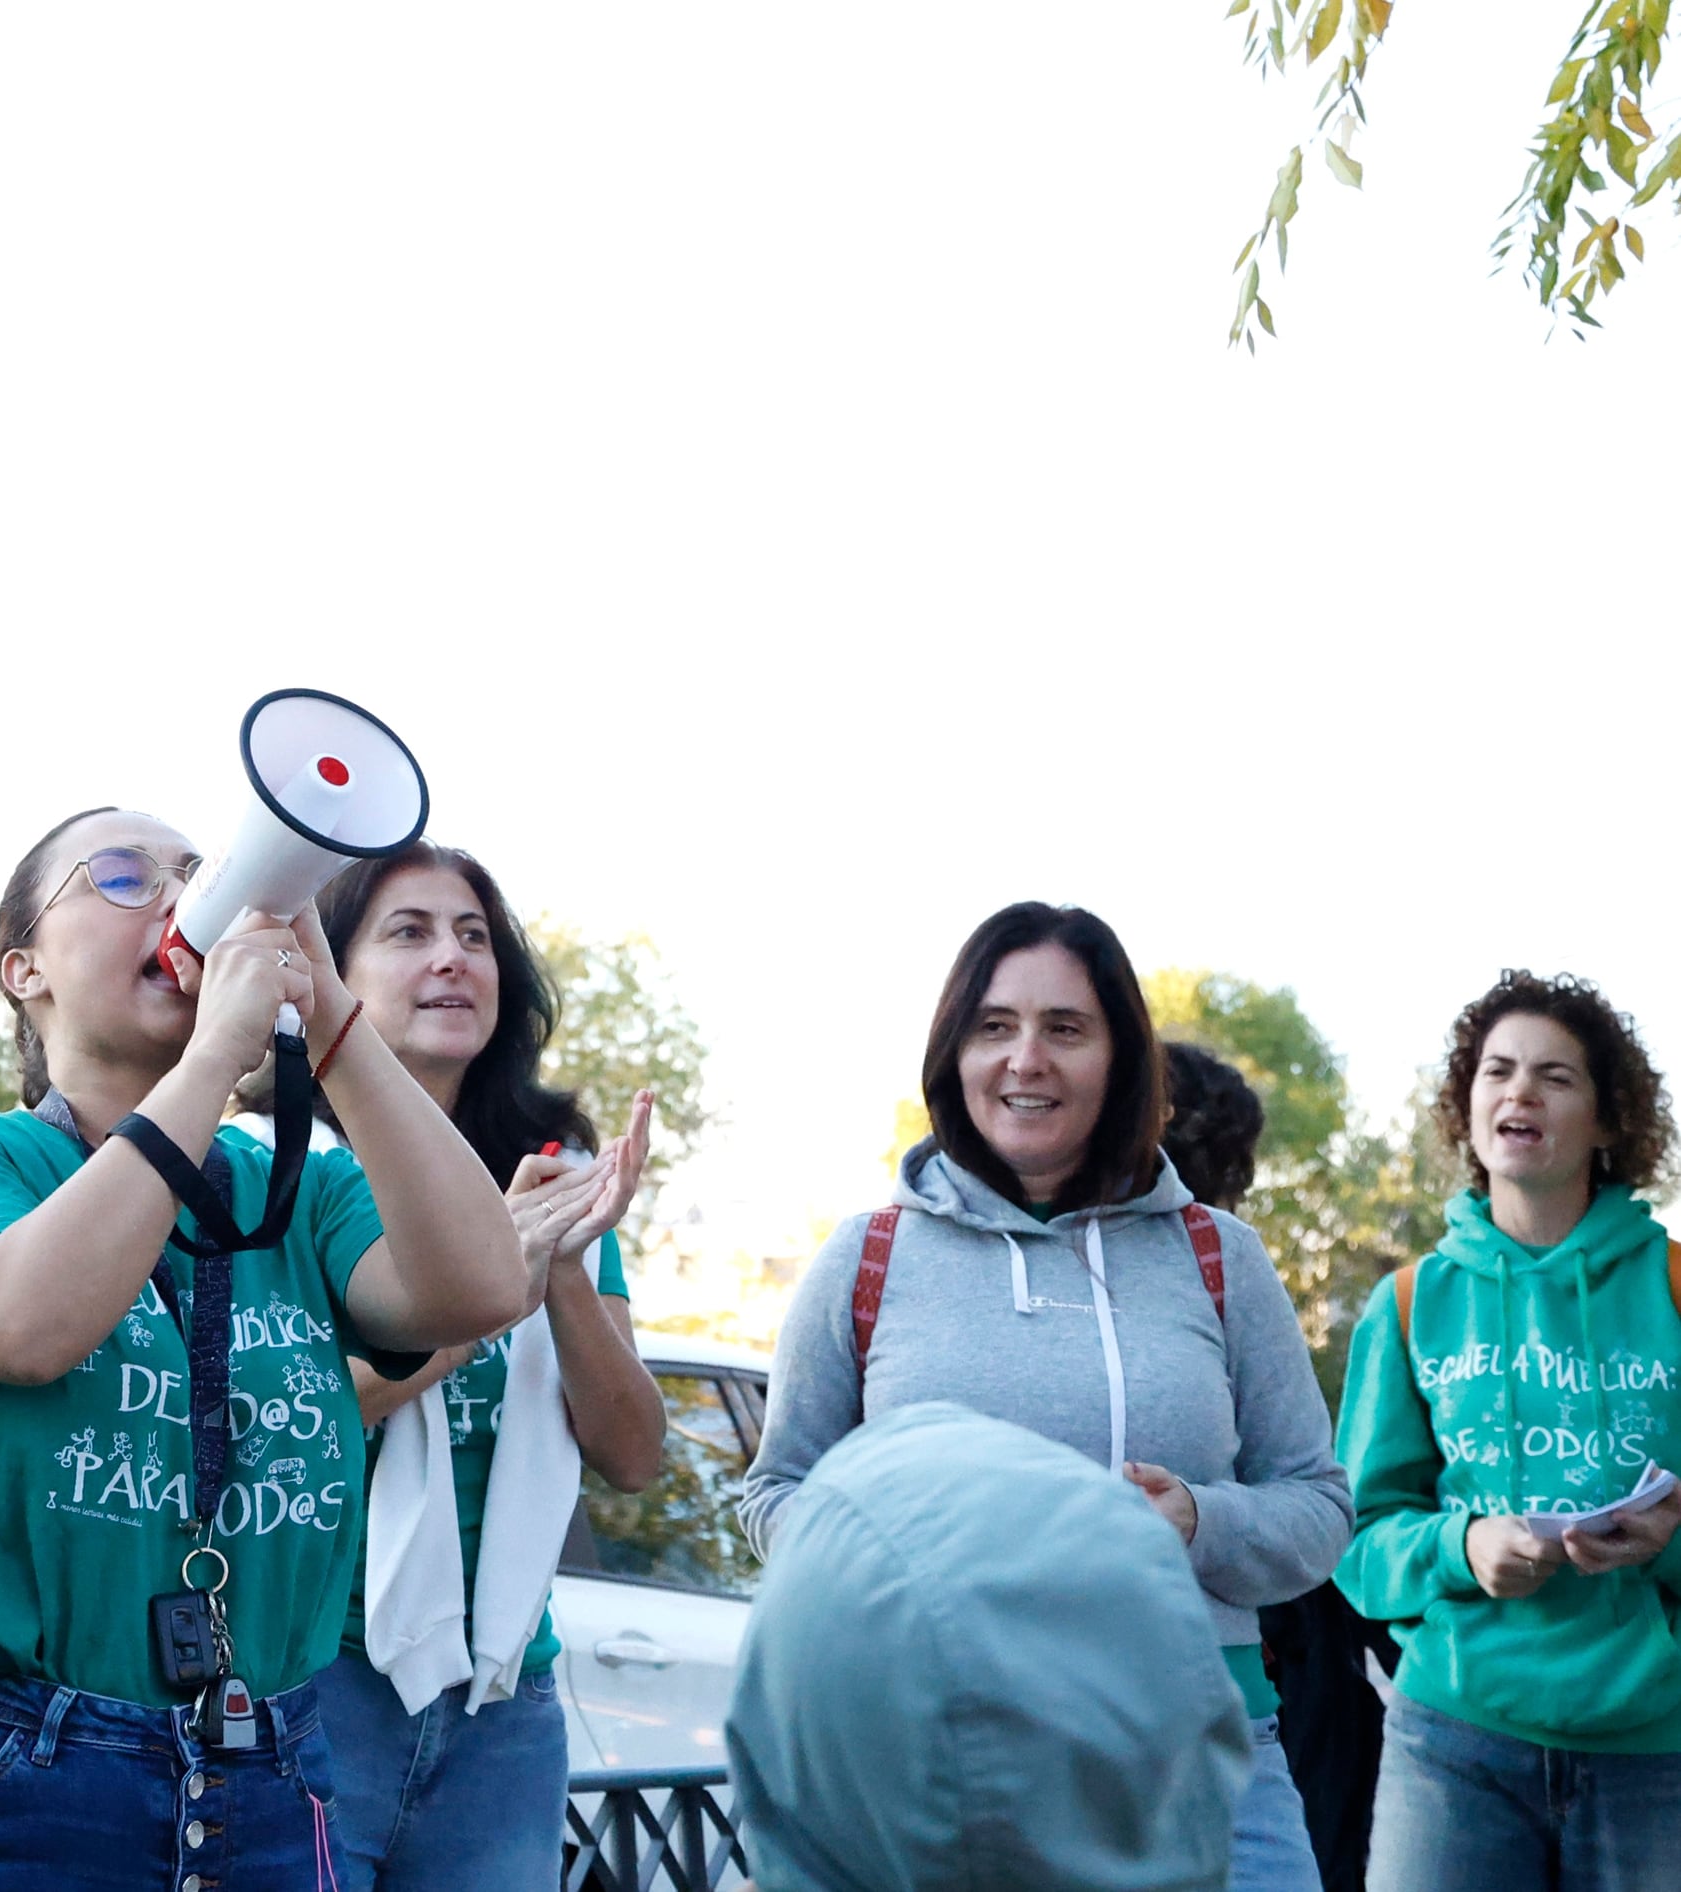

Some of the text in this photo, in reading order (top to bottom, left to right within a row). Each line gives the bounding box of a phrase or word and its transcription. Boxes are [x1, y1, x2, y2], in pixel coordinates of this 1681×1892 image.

[118, 1363, 189, 1424] DE
[1440, 1427, 1478, 1465] DE
[73, 1451, 347, 1537] PARA OD@S
